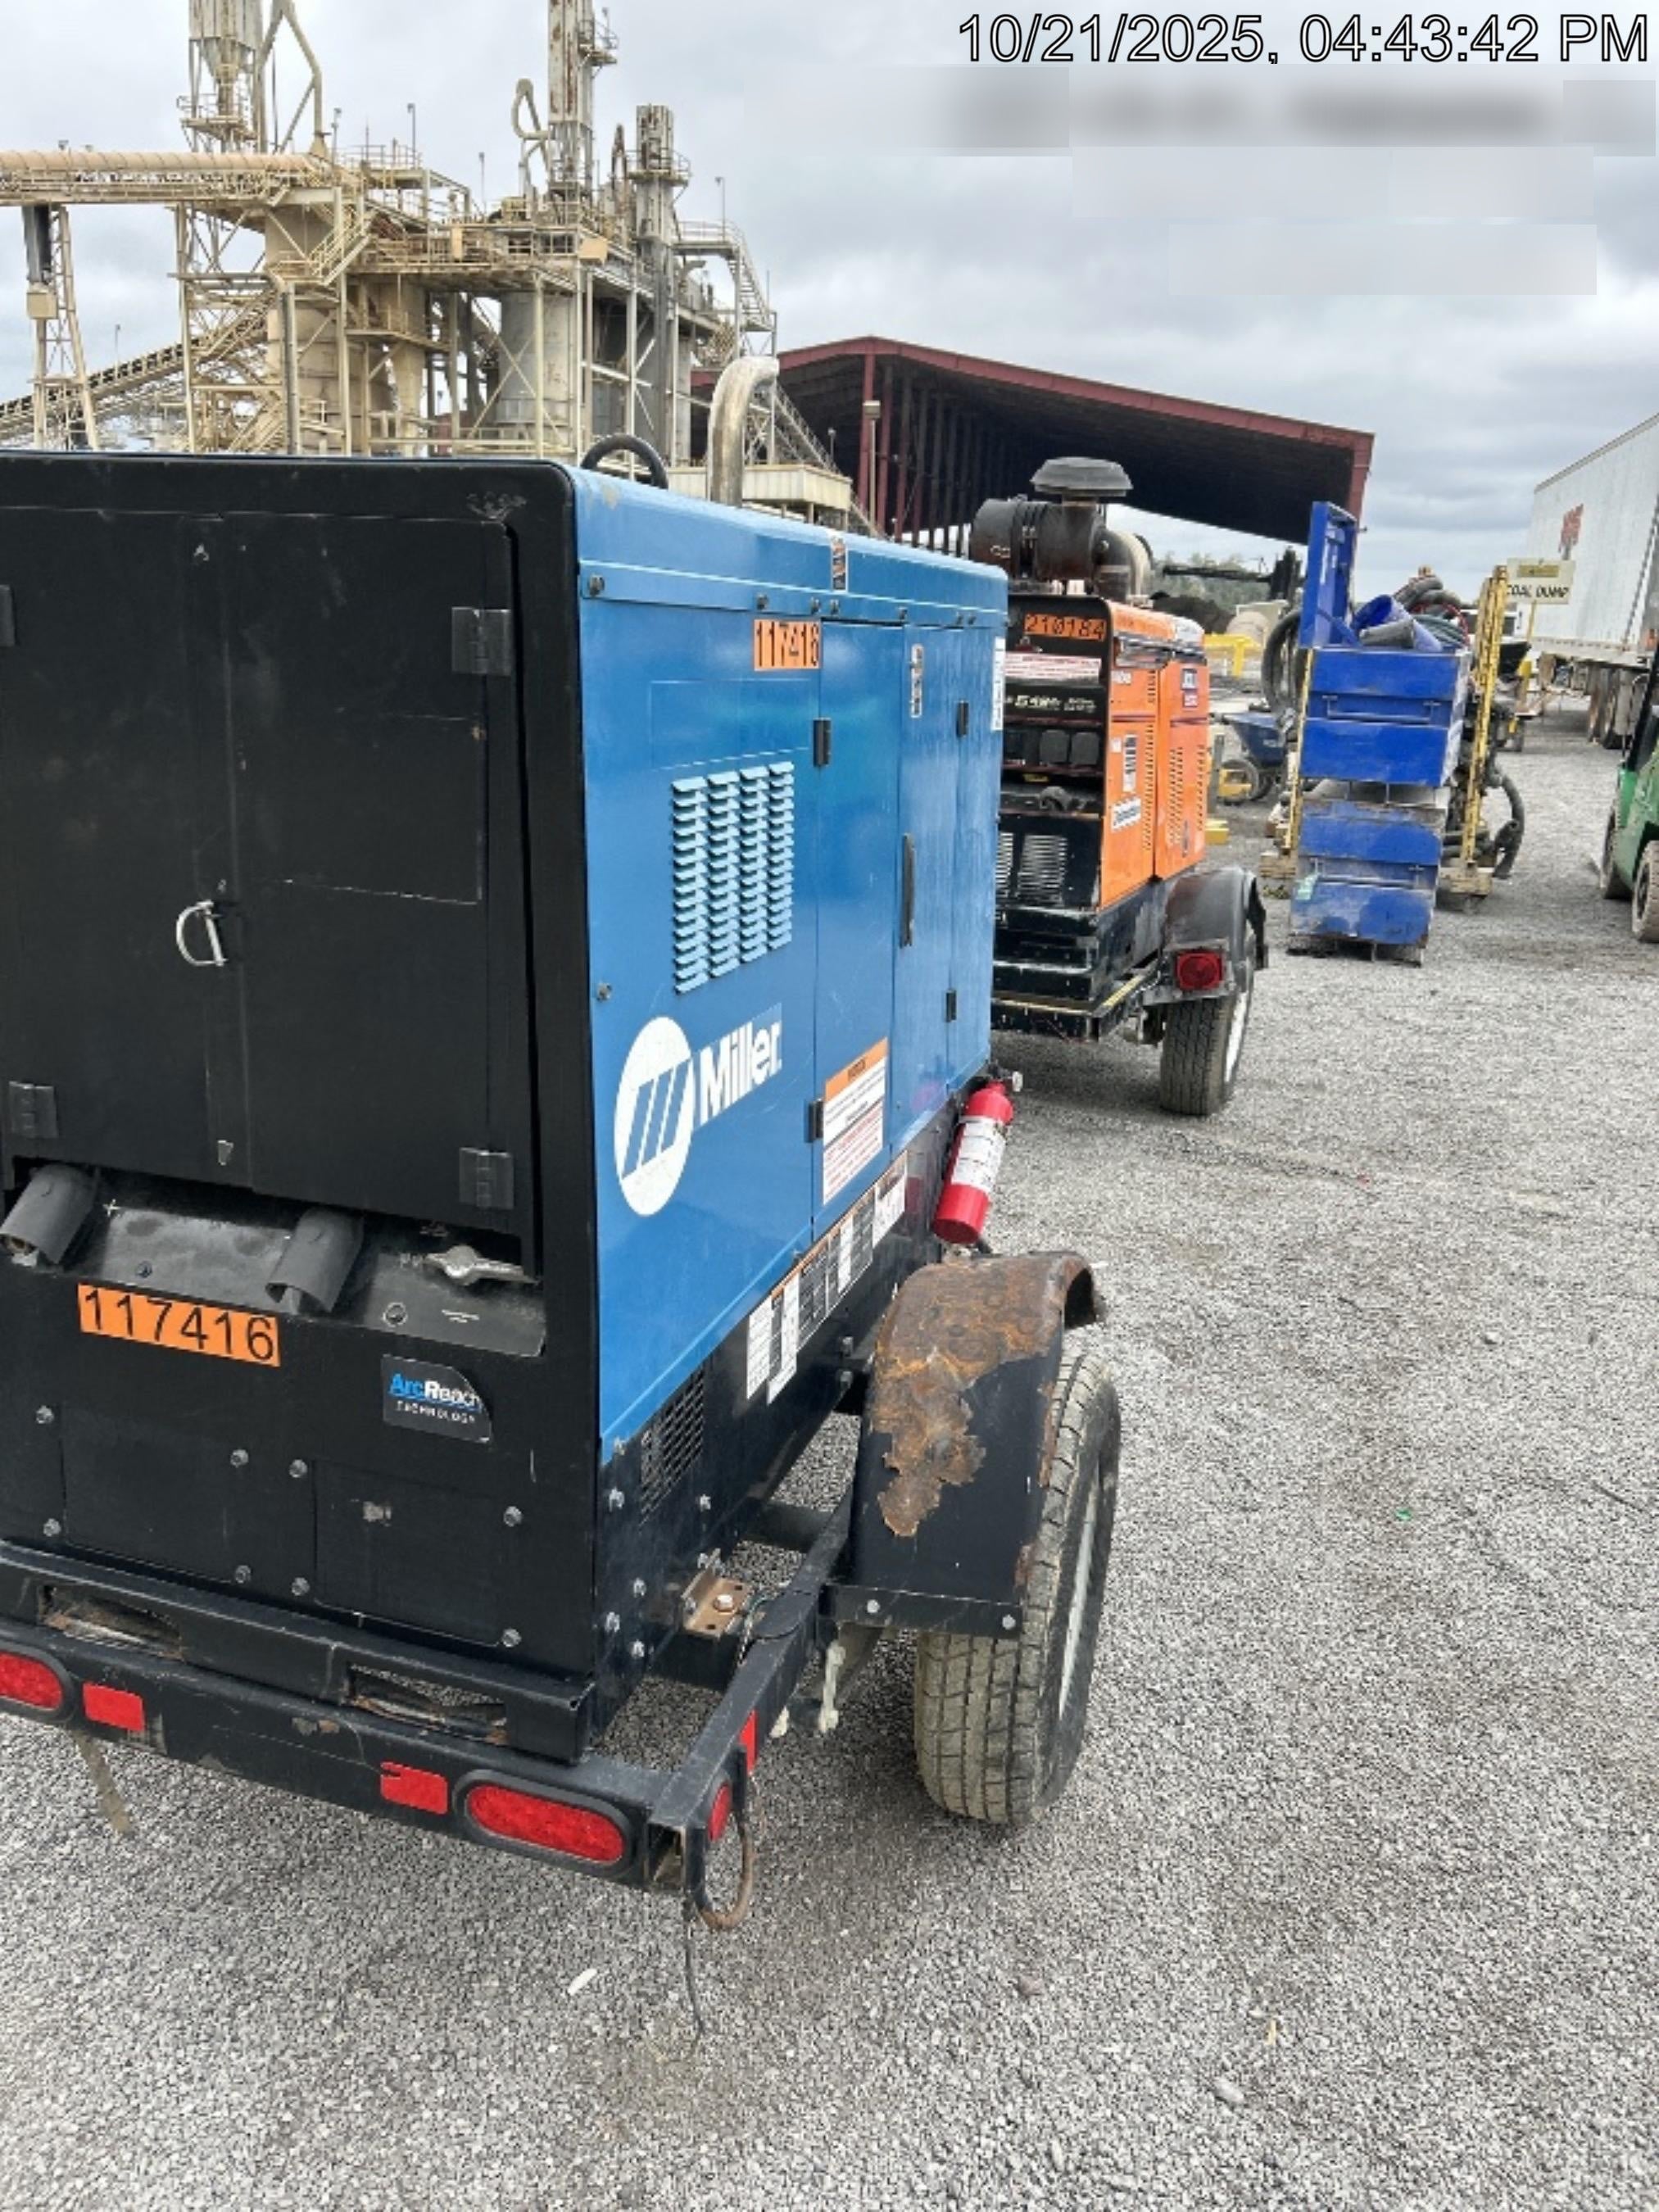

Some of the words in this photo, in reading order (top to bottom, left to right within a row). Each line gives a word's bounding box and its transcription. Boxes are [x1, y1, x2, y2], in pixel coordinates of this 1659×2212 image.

[1536, 586, 1569, 598] DUMP
[756, 621, 819, 667] 117416
[1025, 614, 1104, 640] 210184
[84, 1289, 274, 1362] 117416
[388, 1372, 482, 1408] ArcReach
